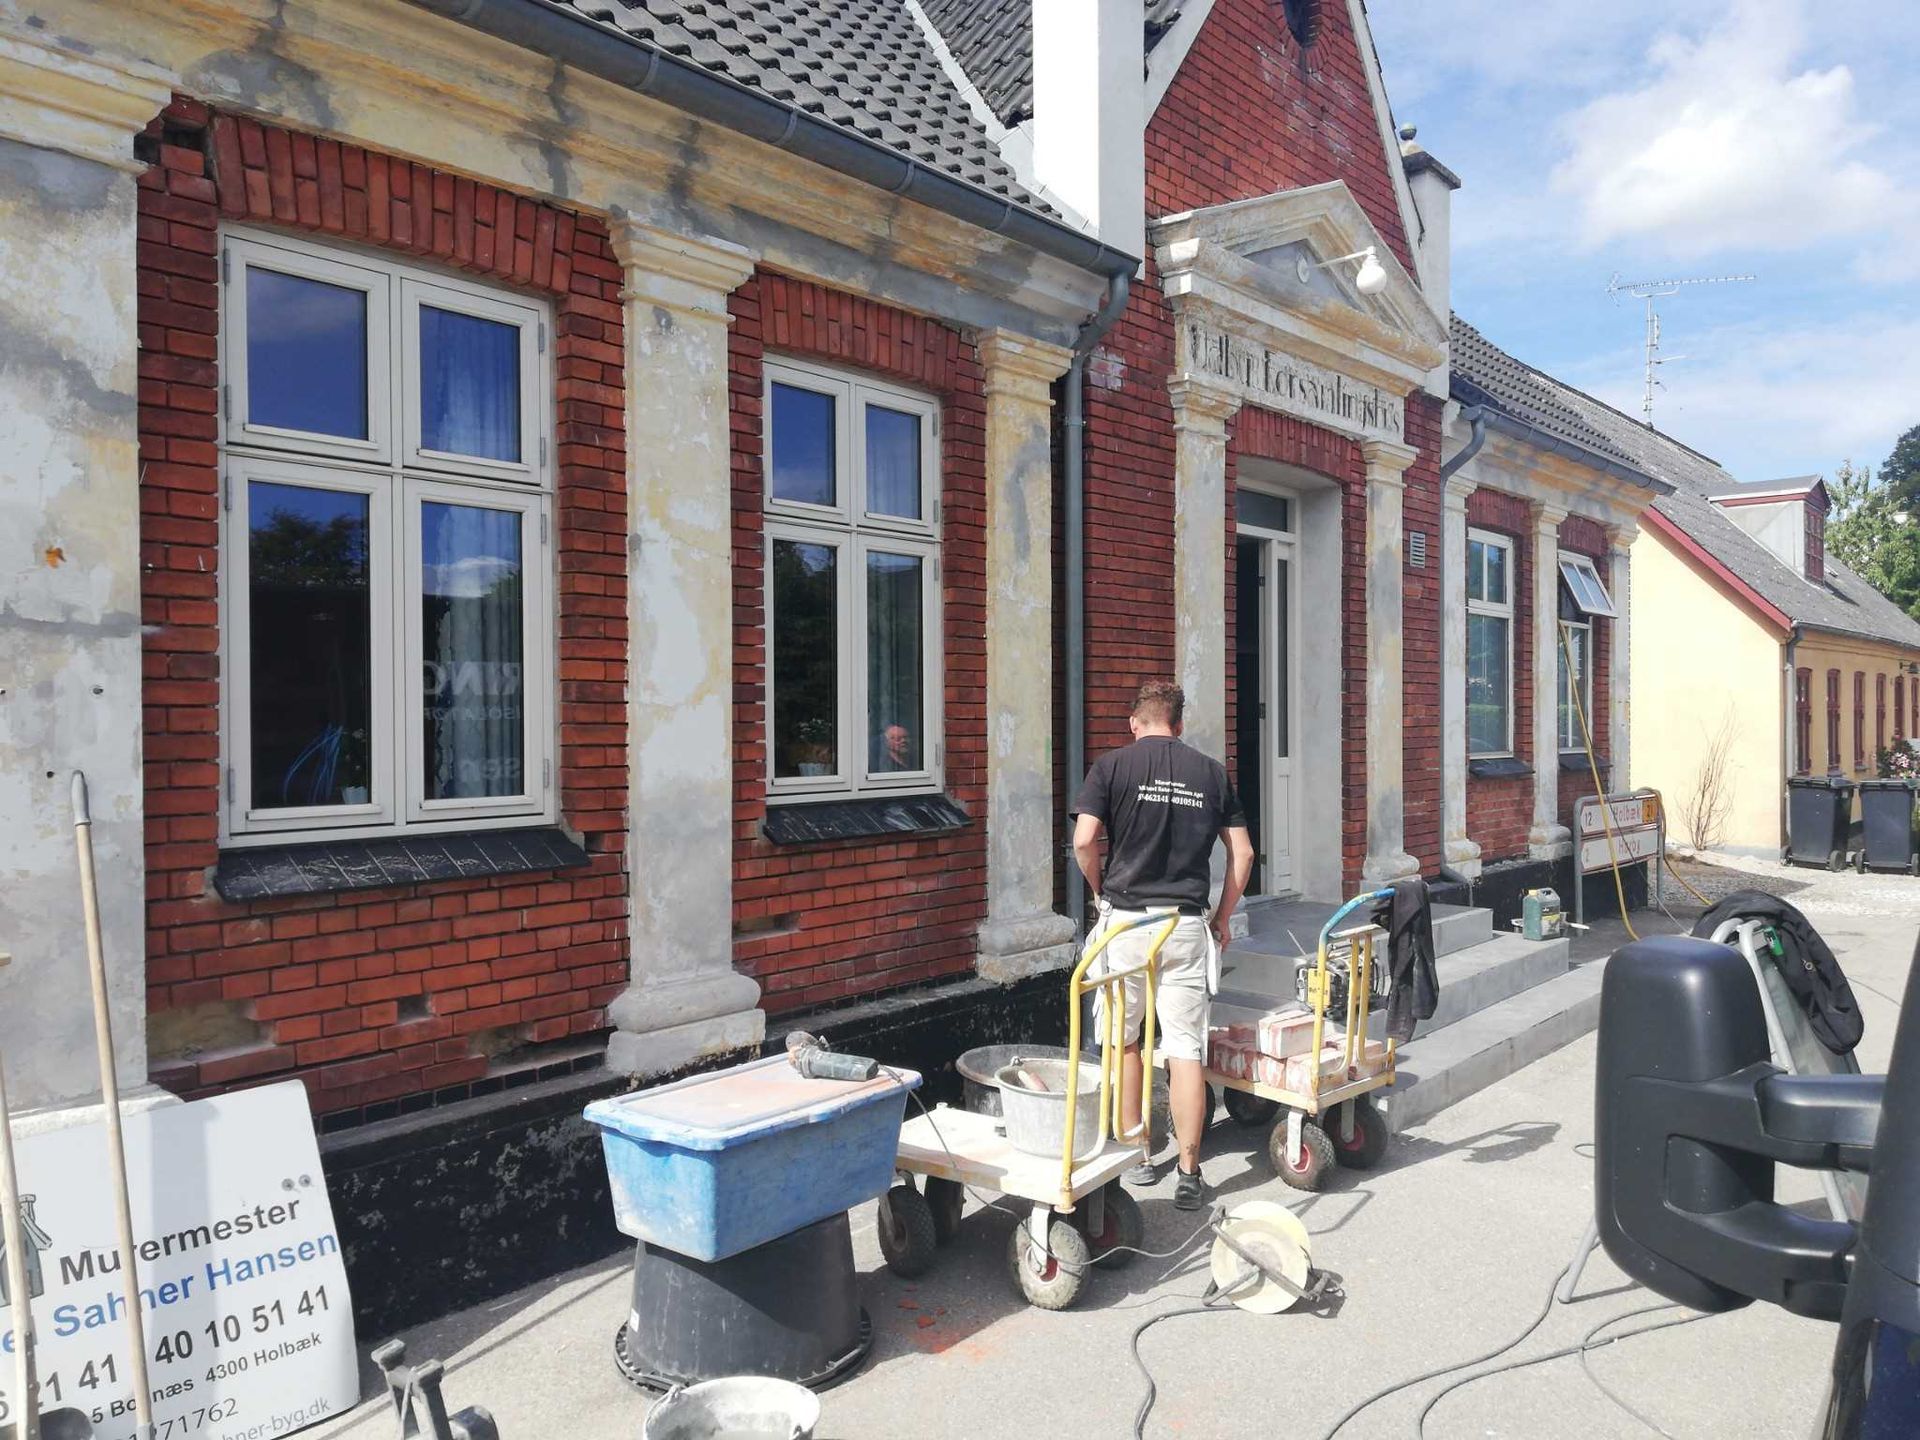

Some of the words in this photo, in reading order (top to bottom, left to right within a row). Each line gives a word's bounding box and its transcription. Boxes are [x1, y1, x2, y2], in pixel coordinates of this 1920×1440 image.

[59, 1198, 301, 1285] Muermester
[205, 1233, 338, 1291] Hansen
[78, 1354, 119, 1391] 41
[154, 1330, 194, 1365] 40
[204, 1314, 242, 1349] 10
[252, 1300, 286, 1334] 51
[296, 1285, 330, 1317] 41
[110, 1380, 195, 1419] Bonæs
[205, 1357, 249, 1383] 4300
[254, 1332, 323, 1368] Holbæk
